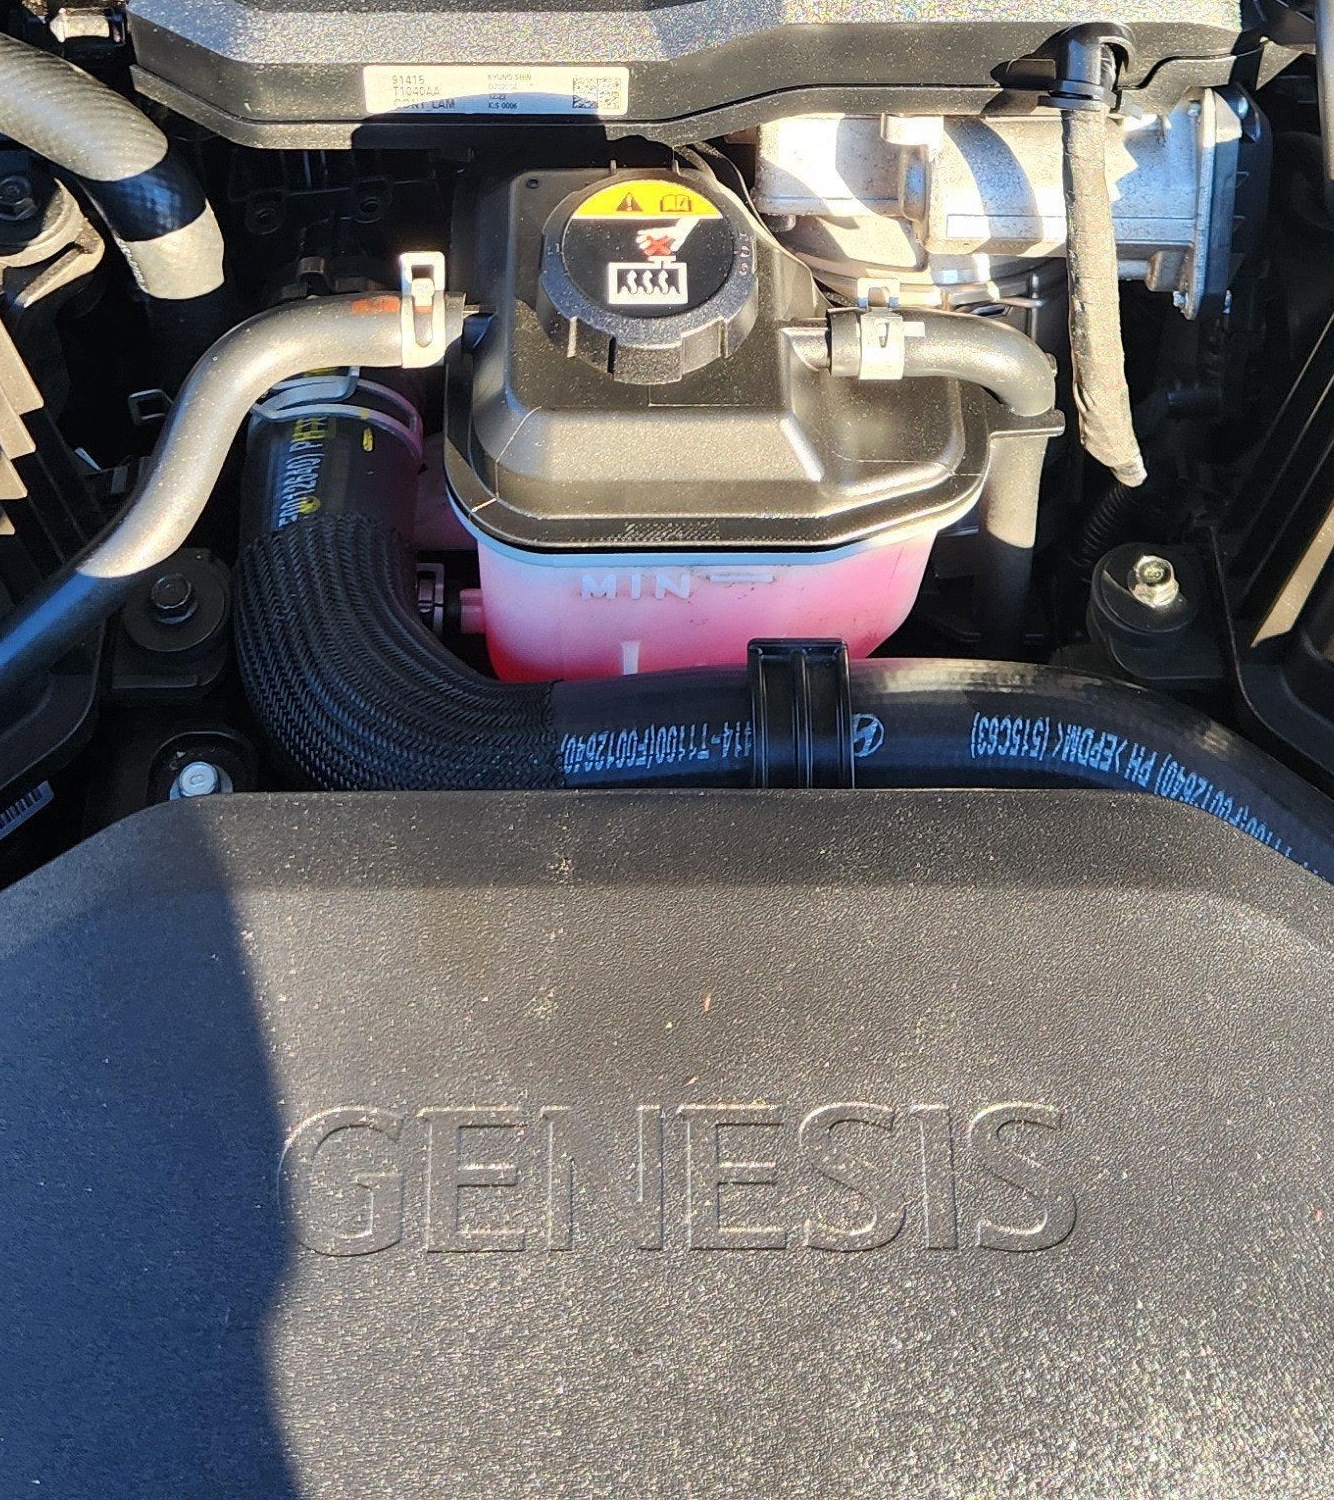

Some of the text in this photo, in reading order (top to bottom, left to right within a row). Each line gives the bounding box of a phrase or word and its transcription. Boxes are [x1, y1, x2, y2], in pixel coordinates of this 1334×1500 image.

[391, 74, 425, 86] 91415
[392, 86, 441, 97] T1040AA
[580, 573, 691, 600] MIN
[1123, 739, 1158, 788] PH
[277, 1100, 1079, 1258] GENESIS
